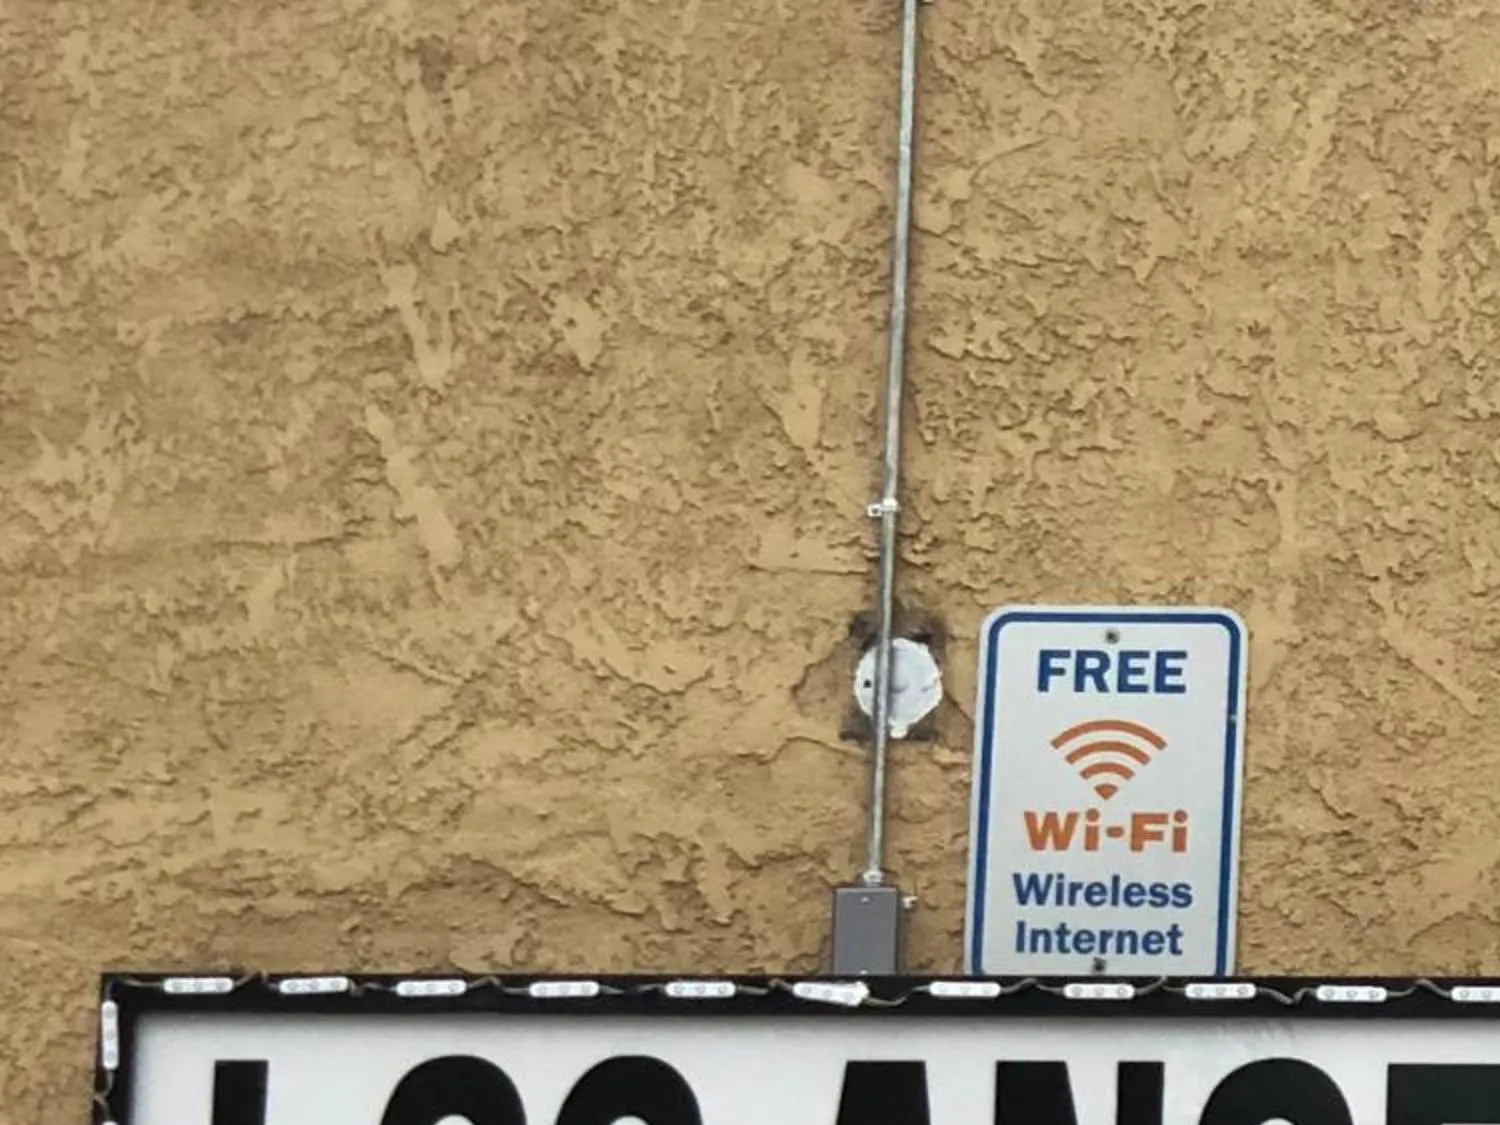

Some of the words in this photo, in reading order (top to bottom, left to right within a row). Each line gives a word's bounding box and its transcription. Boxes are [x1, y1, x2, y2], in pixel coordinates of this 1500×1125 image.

[1037, 649, 1188, 694] FREE
[1023, 808, 1188, 852] Wi-Fi
[1012, 872, 1193, 909] Wireless
[1015, 920, 1184, 956] Internet
